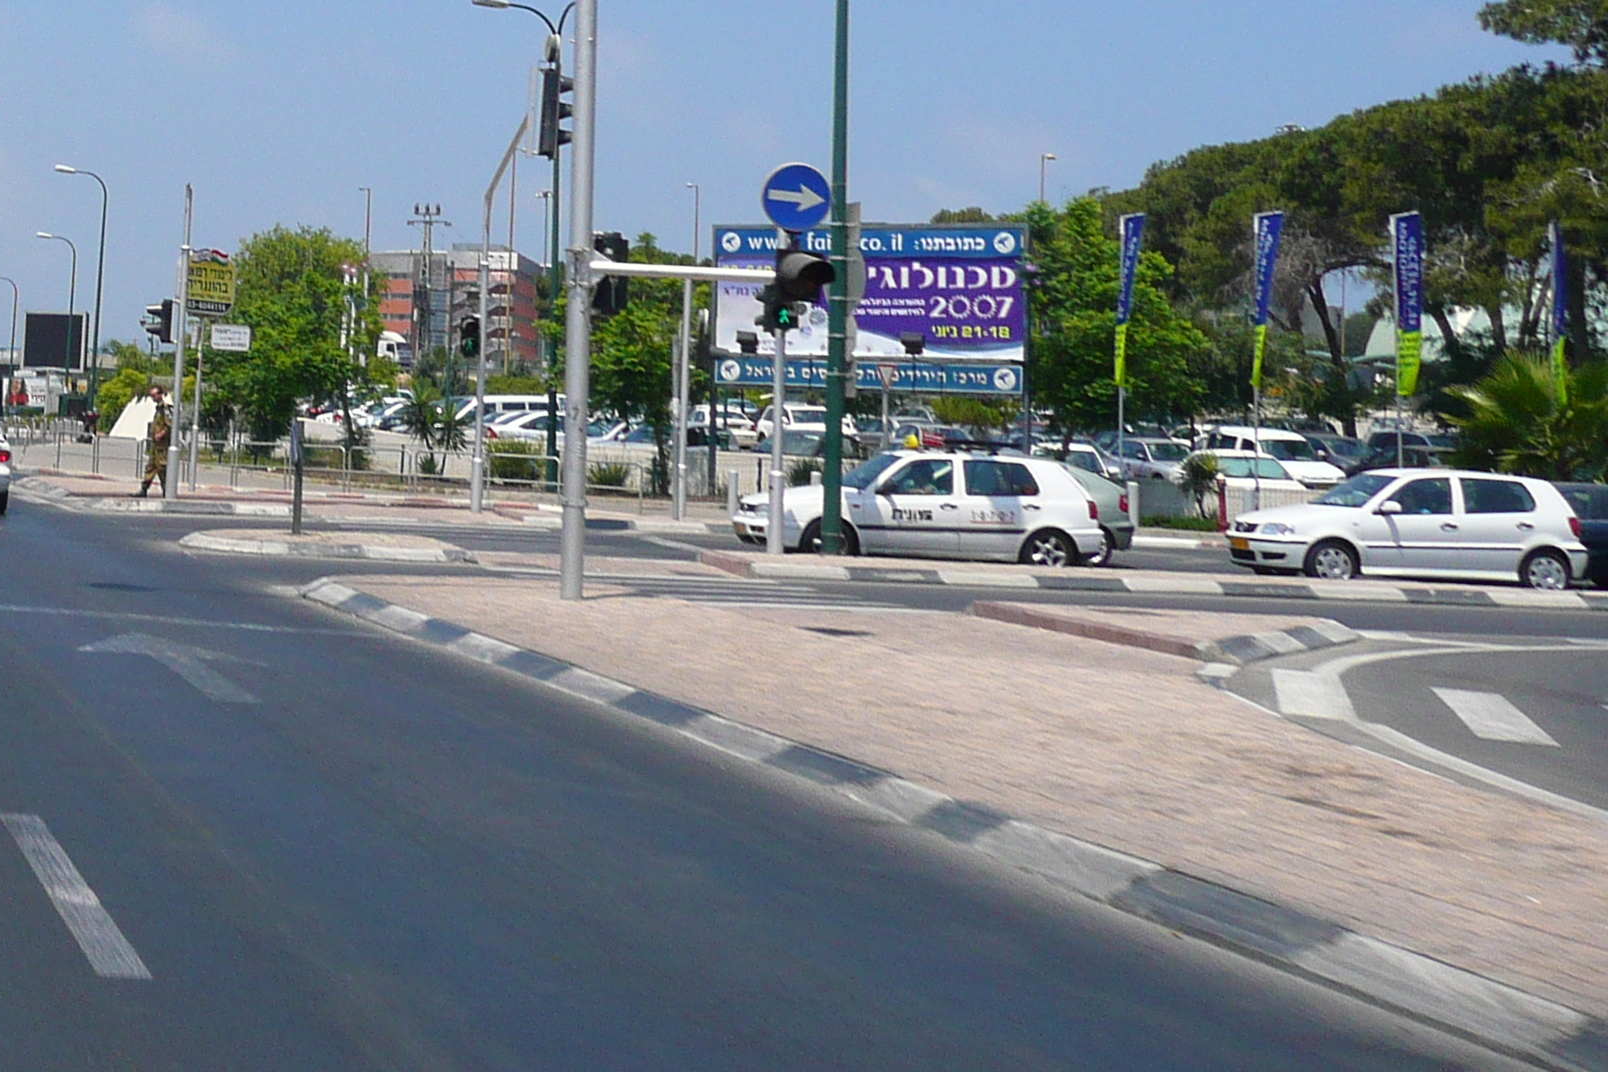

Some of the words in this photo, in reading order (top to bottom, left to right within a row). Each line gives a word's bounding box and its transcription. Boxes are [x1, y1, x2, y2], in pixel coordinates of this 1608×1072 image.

[868, 261, 1016, 289] טכנולוגי
[929, 294, 1014, 320] 2007
[952, 371, 988, 385] מרכז
